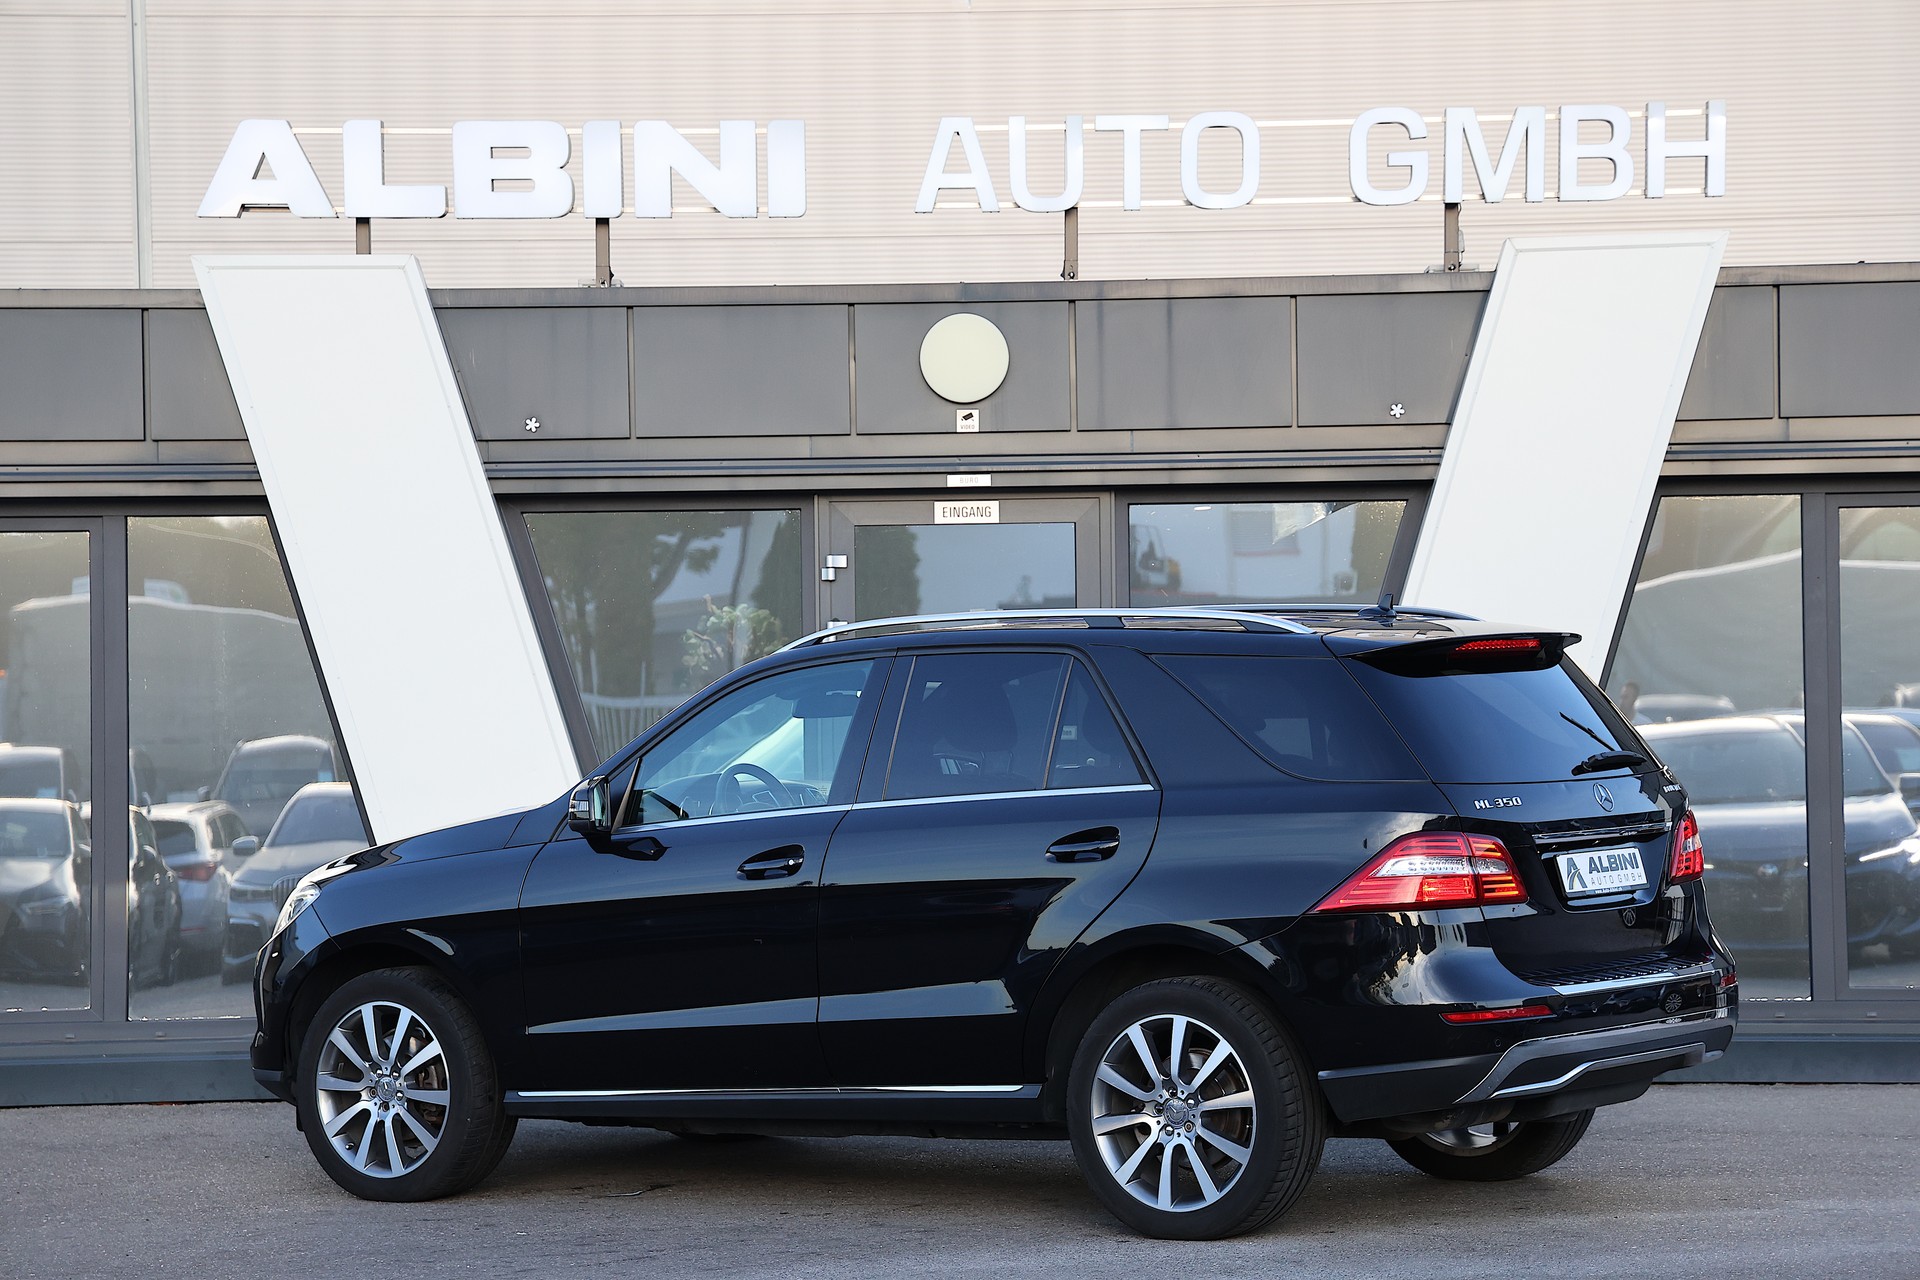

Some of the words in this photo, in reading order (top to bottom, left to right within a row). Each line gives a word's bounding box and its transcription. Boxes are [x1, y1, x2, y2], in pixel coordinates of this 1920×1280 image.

[197, 119, 807, 220] ALBINI
[915, 111, 1261, 213] AUTO
[1349, 99, 1727, 207] GMBH
[942, 506, 992, 519] EINGANG
[1494, 796, 1523, 808] 350
[1588, 852, 1640, 874] ALBINI
[1590, 875, 1615, 886] AUTO
[1617, 872, 1643, 883] GMBH
